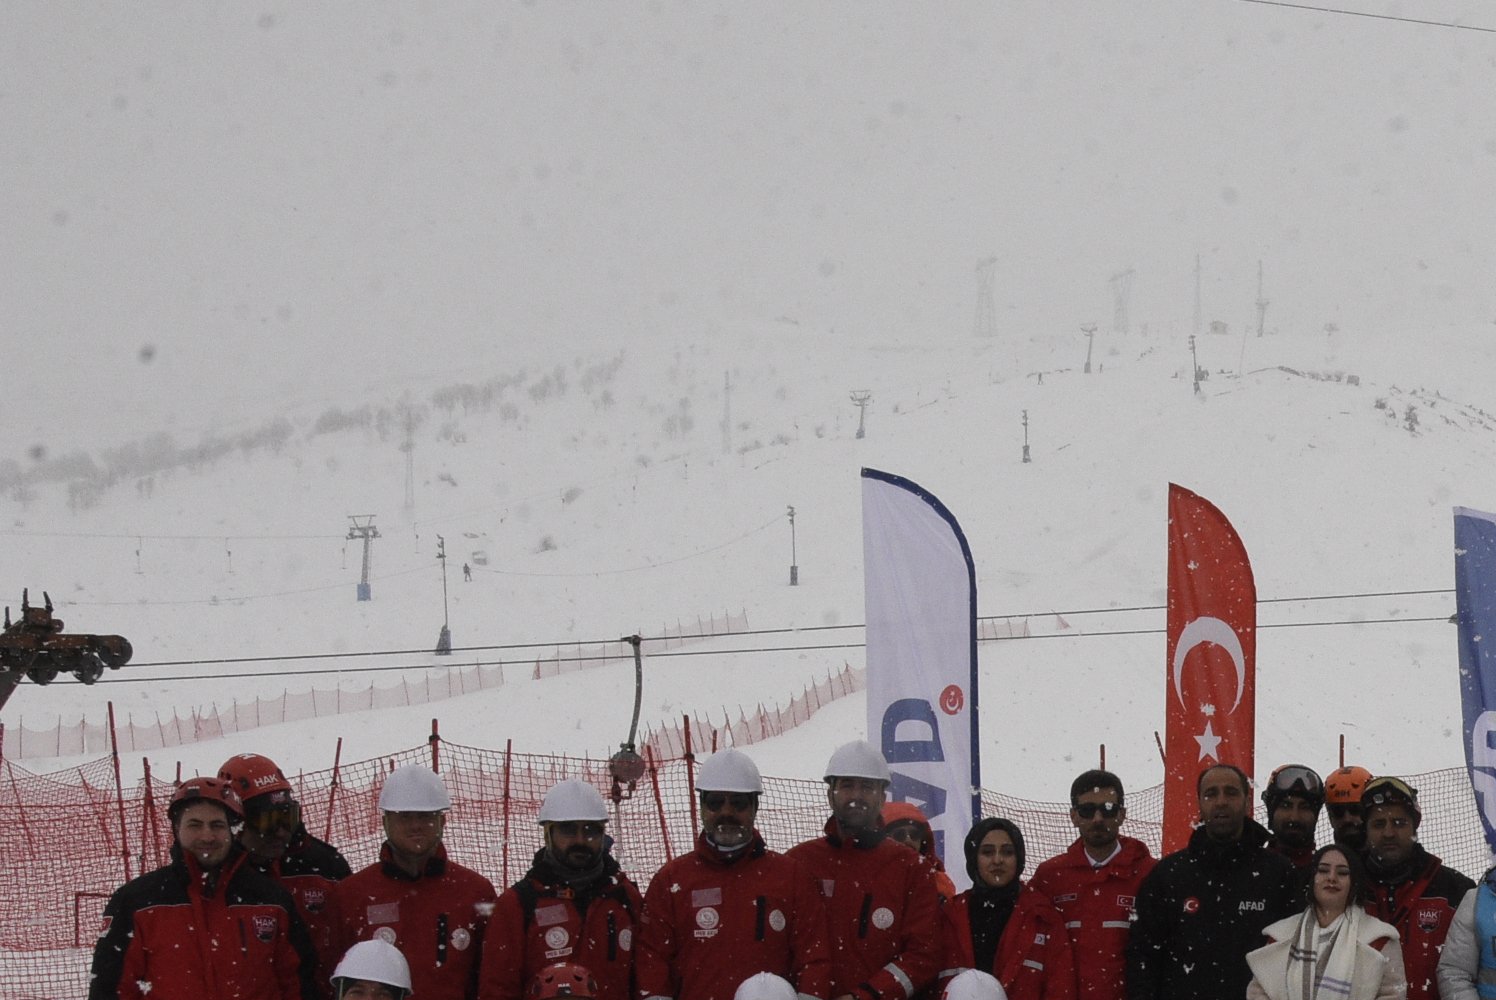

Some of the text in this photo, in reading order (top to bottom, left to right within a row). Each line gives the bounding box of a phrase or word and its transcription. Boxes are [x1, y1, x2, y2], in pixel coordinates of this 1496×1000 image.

[254, 774, 279, 787] HAK
[304, 890, 324, 899] HAK
[1238, 900, 1265, 911] AFAD
[1419, 911, 1438, 919] HAK
[255, 918, 274, 928] HAK
